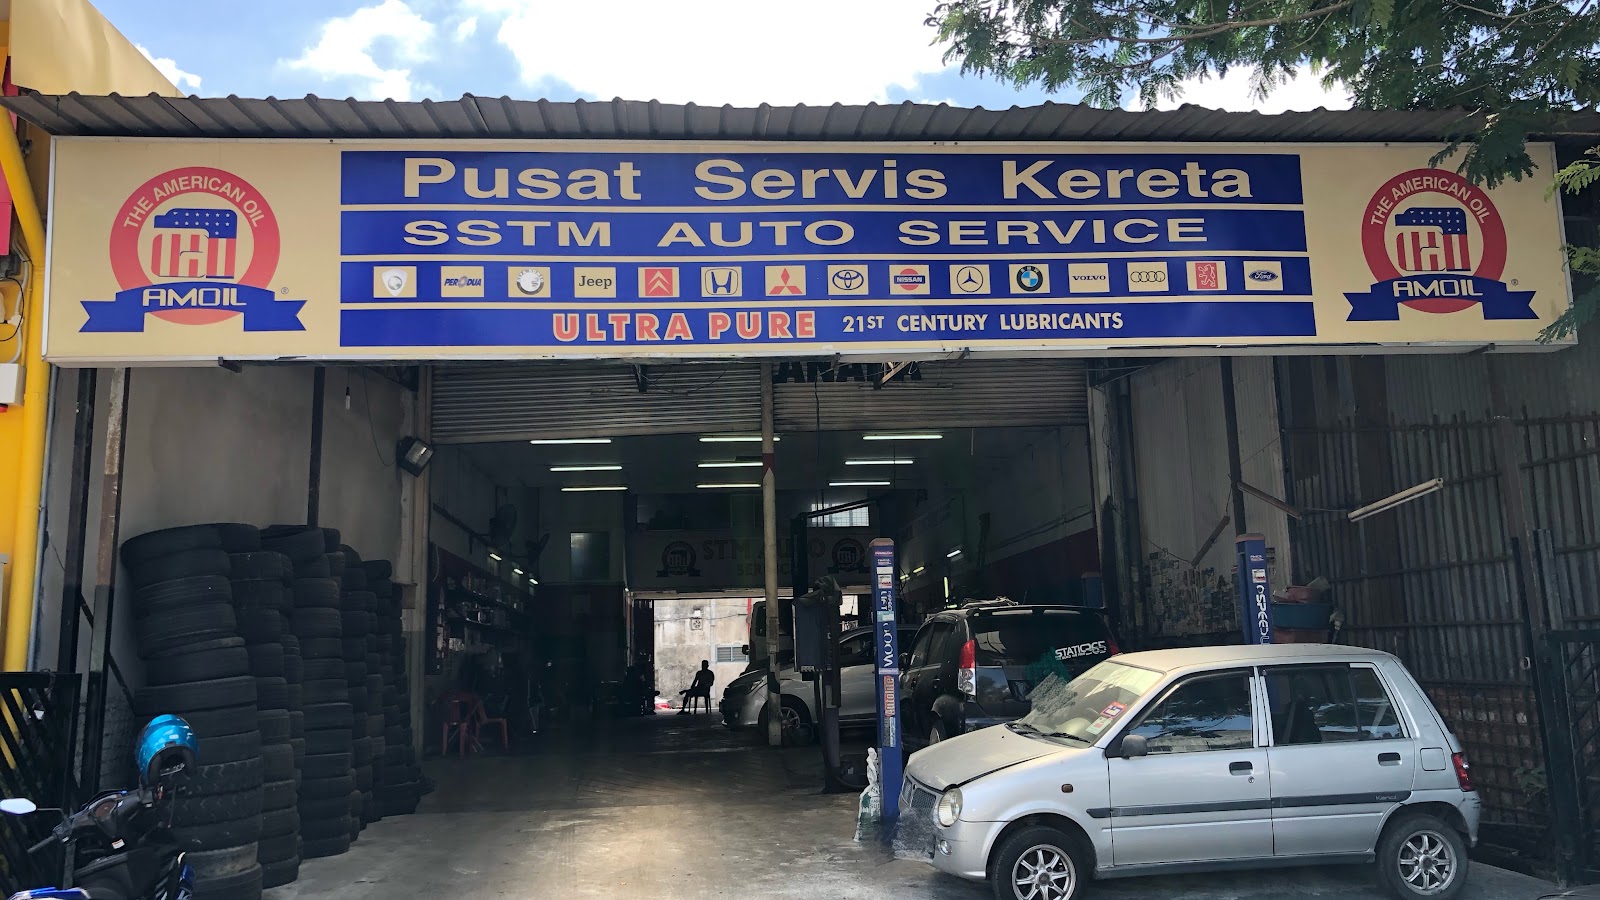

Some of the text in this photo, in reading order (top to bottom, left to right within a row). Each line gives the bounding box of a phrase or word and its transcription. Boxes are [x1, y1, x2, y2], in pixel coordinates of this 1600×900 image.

[403, 158, 1254, 201] Pusat Servis Kereta
[123, 175, 266, 230] THE AMERICAN OIL
[1370, 176, 1491, 226] THE AMERICAN OIL
[403, 217, 1208, 247] SSTM AUTO SERVICE
[443, 275, 482, 288] PERODUA
[578, 275, 613, 290] Jeep
[1071, 274, 1107, 282] VOLVO
[1392, 279, 1484, 297] AMOIL
[142, 287, 247, 307] AMOIL
[552, 310, 1124, 342] ULTRA PURE 21ST CENTURY LUBRICANTS
